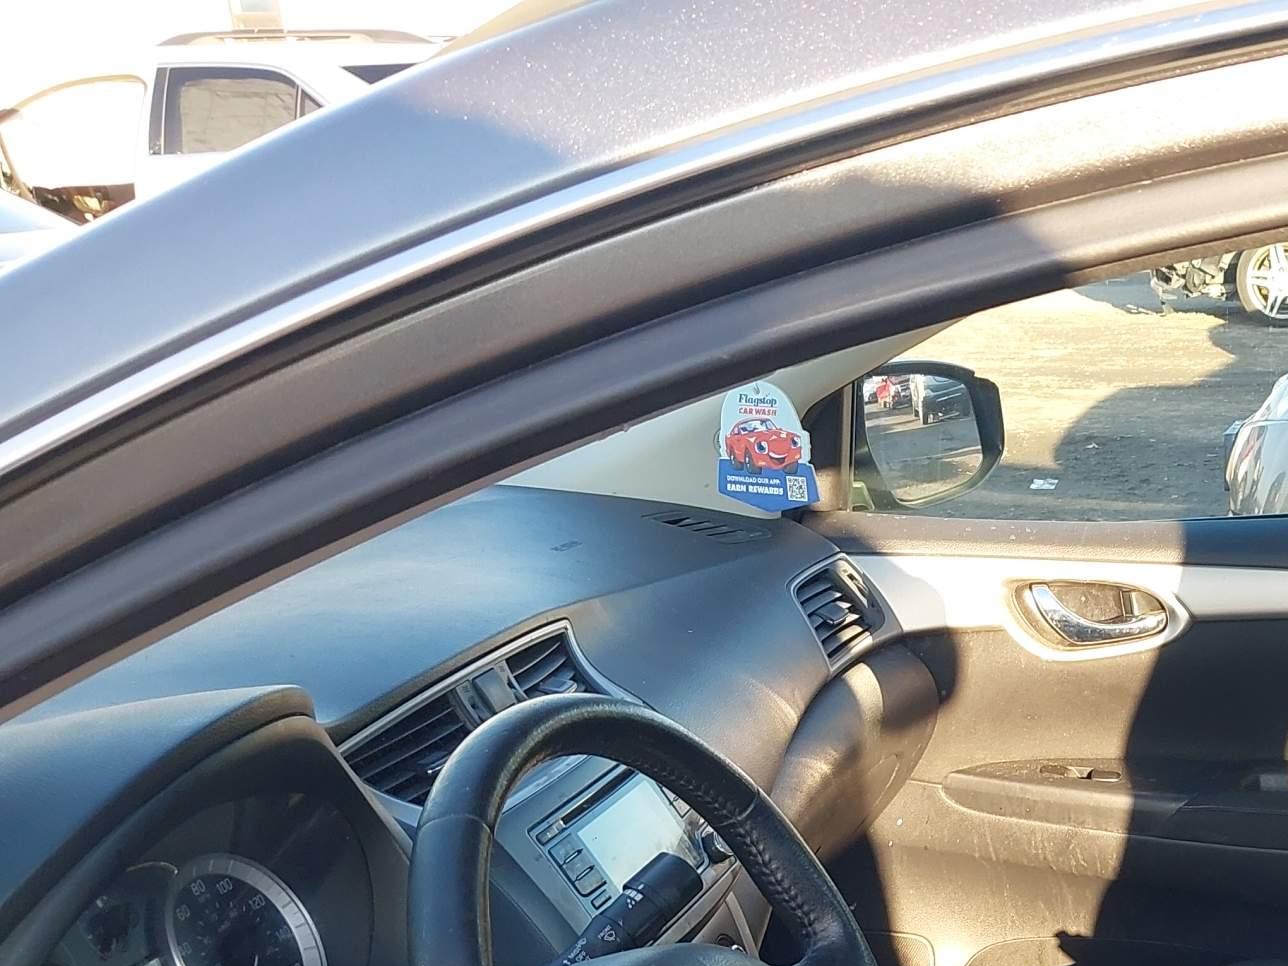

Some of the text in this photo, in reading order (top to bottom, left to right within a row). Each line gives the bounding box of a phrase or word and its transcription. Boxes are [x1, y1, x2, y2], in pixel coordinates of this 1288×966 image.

[738, 393, 777, 408] Flagstop
[738, 407, 777, 416] CAR WASH
[726, 474, 757, 484] DOWNLOAD
[757, 477, 769, 485] OUR
[726, 483, 784, 496] EARN REWARDS
[191, 879, 207, 897] 80
[216, 878, 234, 895] 100
[248, 894, 266, 911] 120
[175, 904, 191, 921] 60
